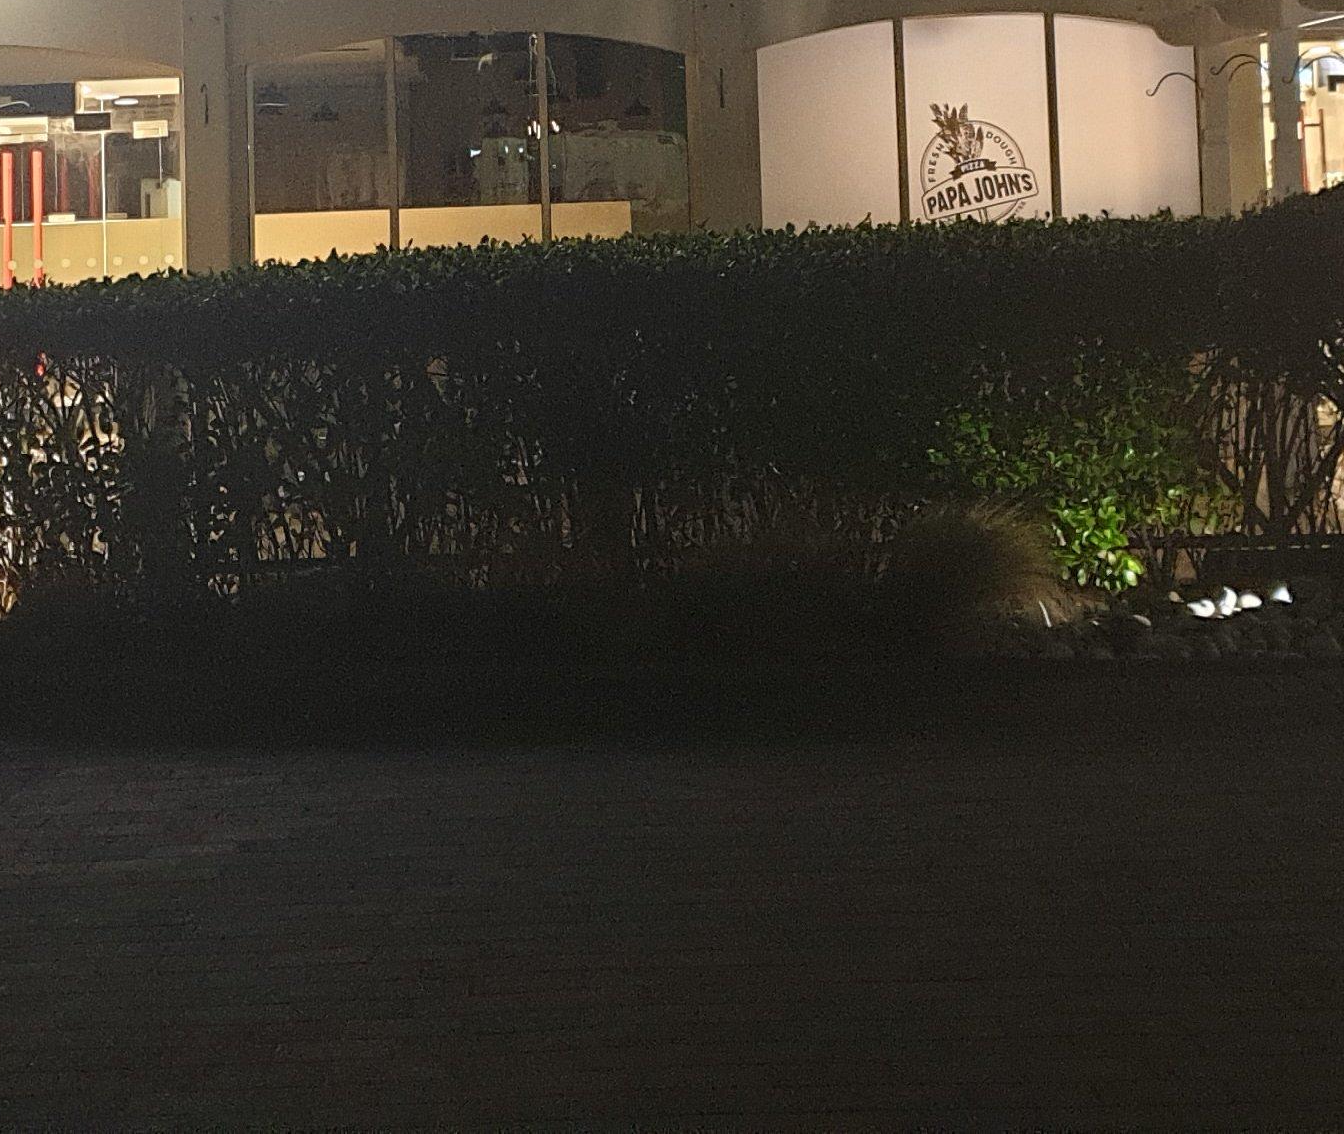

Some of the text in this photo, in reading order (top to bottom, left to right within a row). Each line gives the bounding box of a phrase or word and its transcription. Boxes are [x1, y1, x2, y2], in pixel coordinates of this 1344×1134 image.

[928, 131, 1017, 183] FRESH DOUGH
[927, 173, 1033, 214] PAPA JOHN'S
